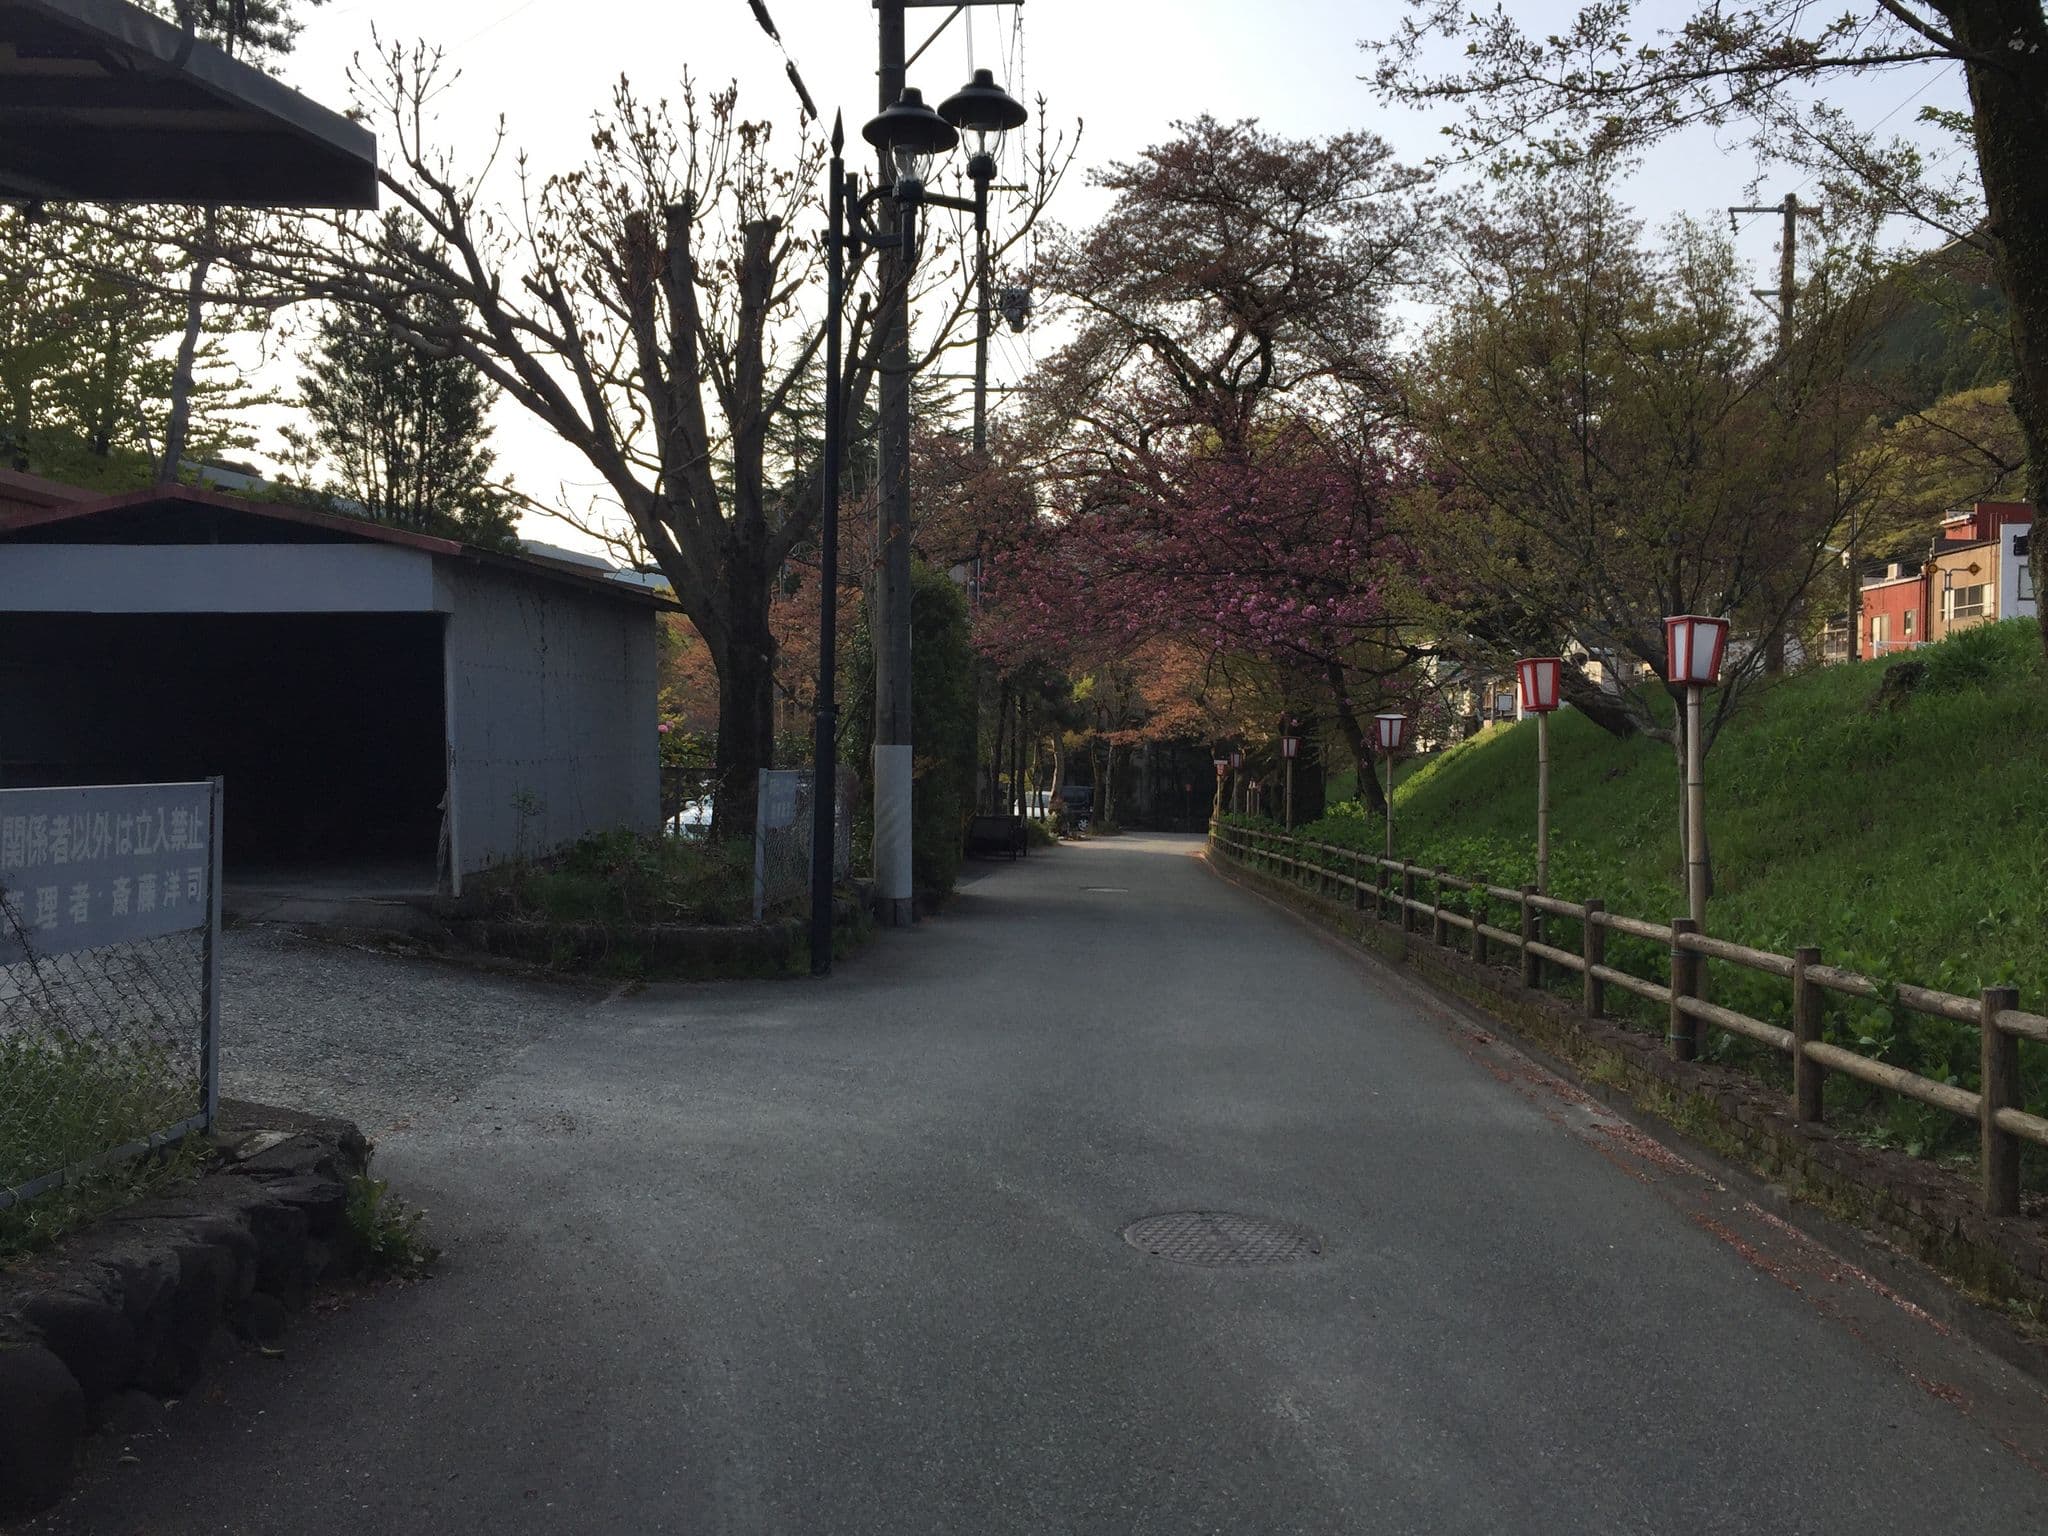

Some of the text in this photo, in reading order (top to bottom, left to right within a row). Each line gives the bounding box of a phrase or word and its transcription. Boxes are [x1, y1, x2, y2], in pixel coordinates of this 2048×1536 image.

[1, 806, 204, 869] 関係者以外は立入禁止
